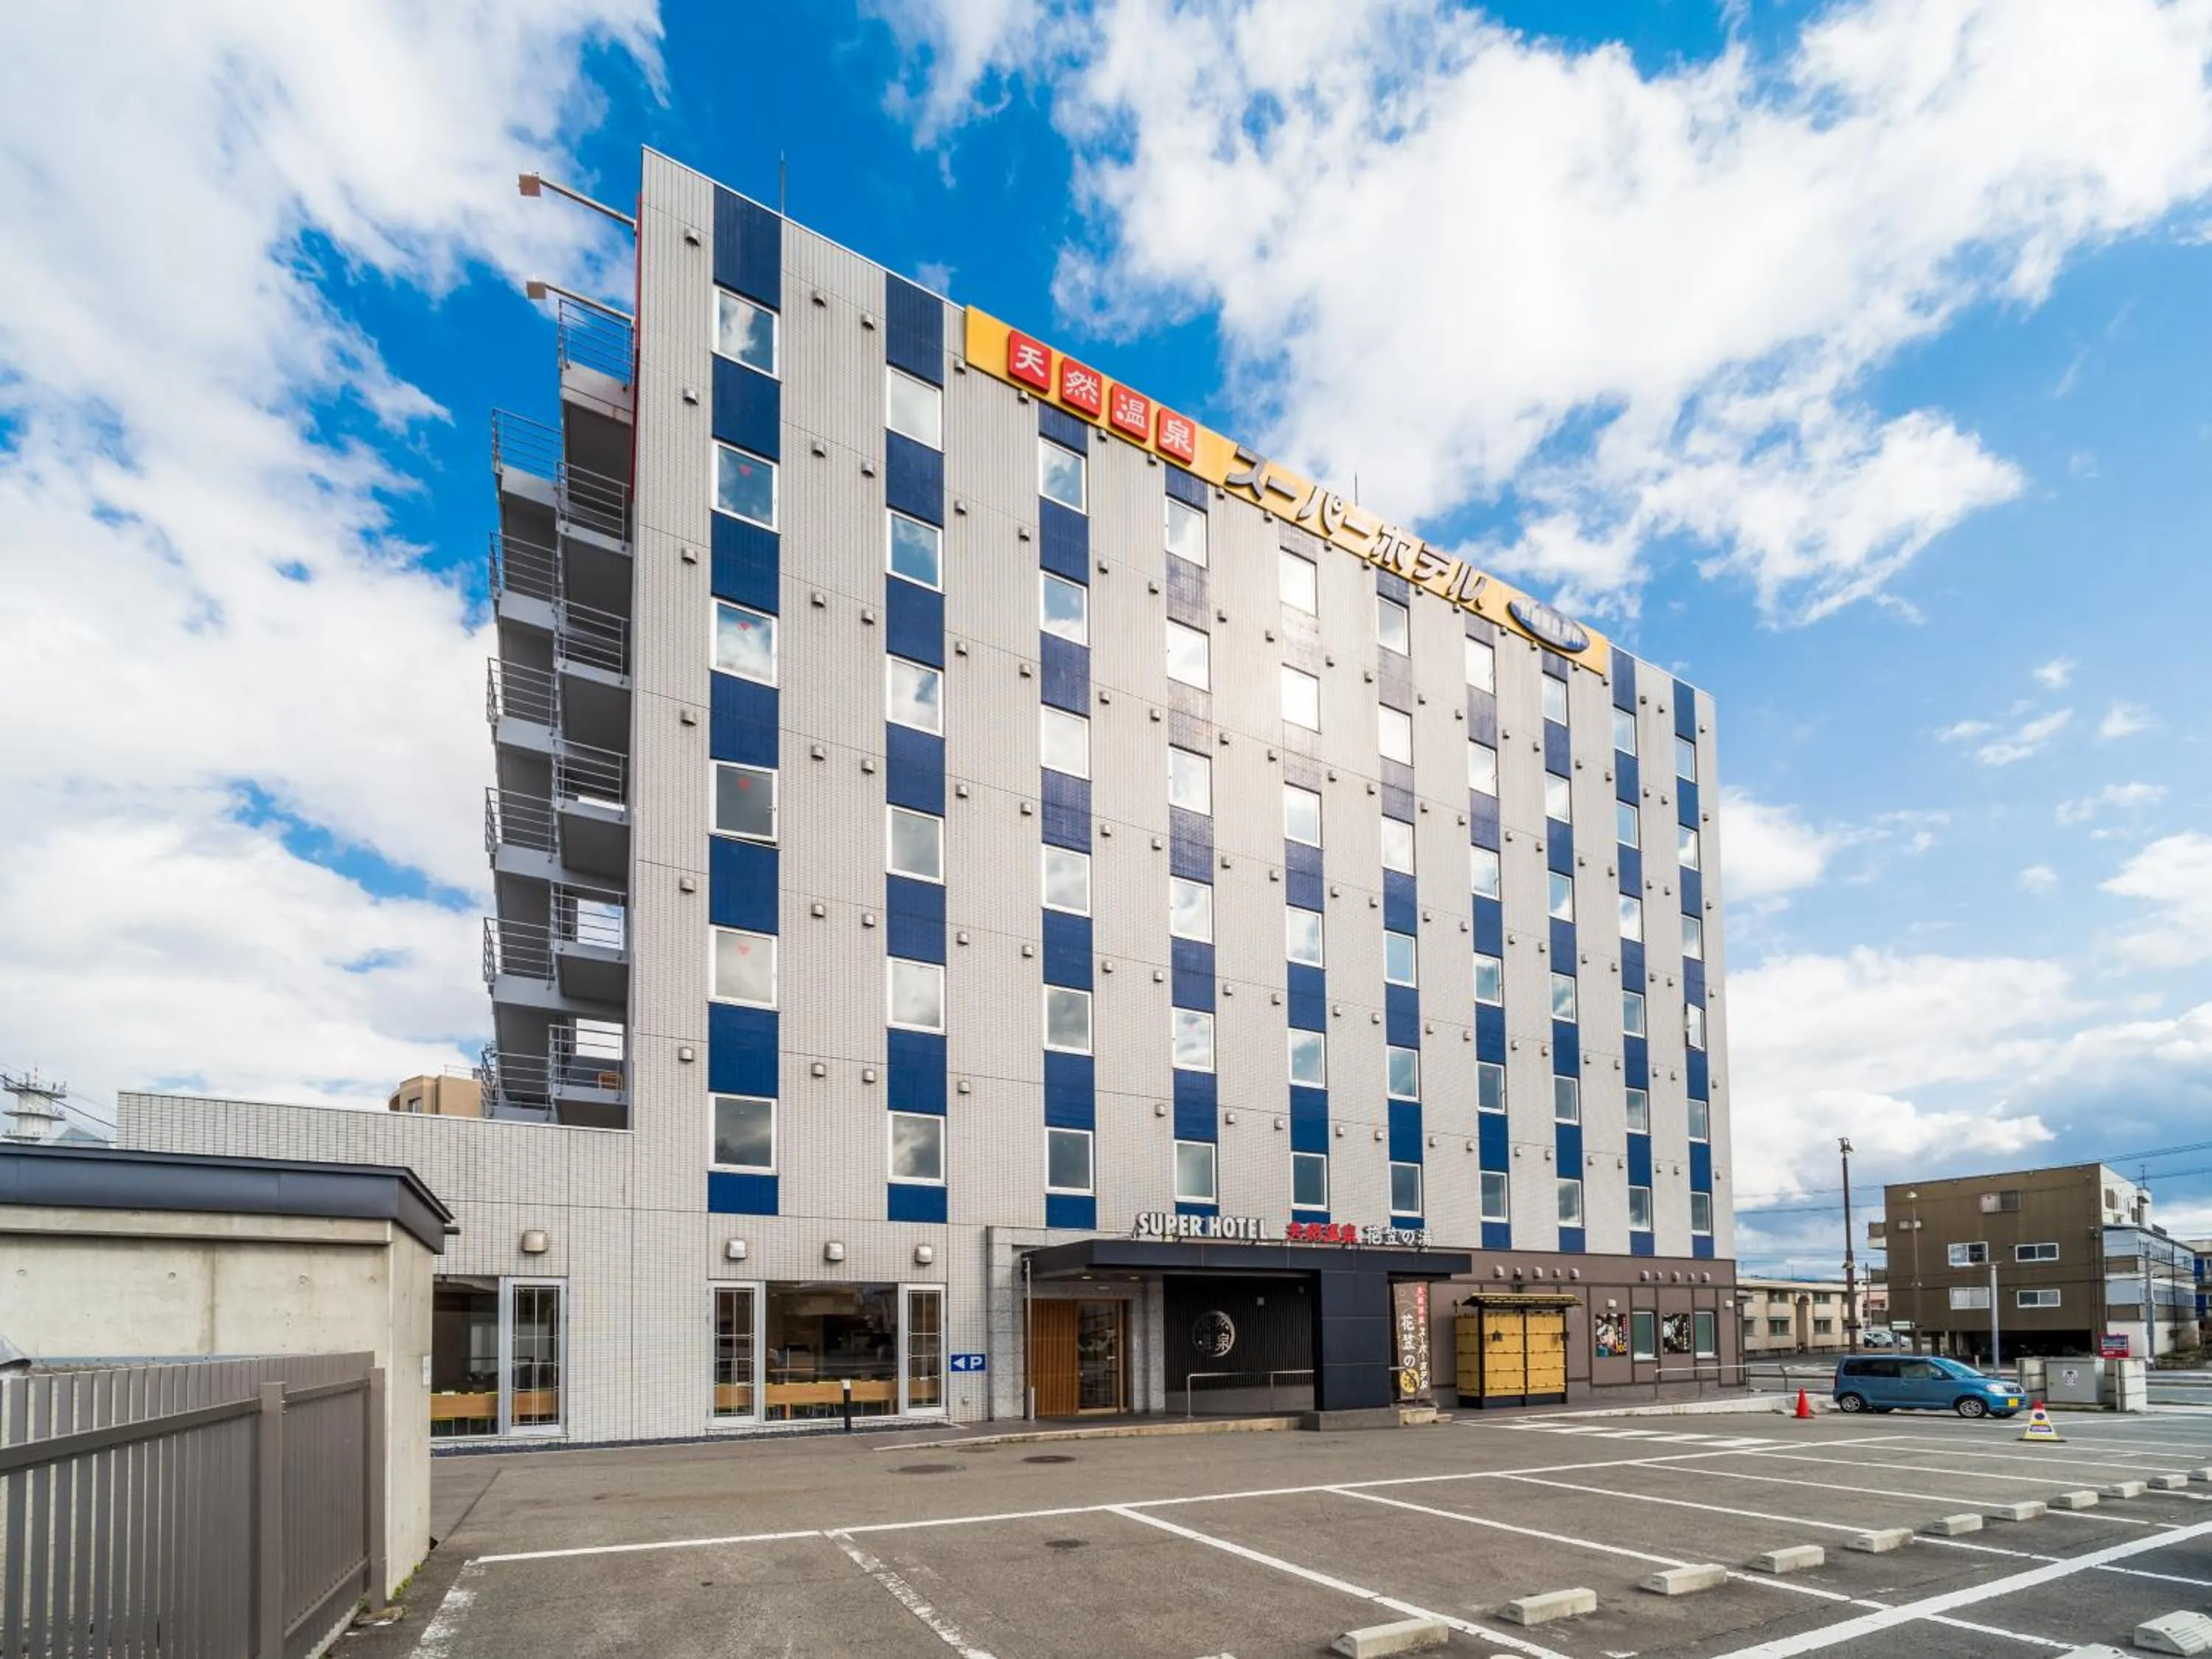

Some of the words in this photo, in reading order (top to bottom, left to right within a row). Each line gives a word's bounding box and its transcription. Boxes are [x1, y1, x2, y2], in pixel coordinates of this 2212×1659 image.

[1015, 344, 1192, 453] 天然温泉
[1225, 444, 1486, 611] スーパーホテル
[1138, 1212, 1203, 1237] SUPER
[1209, 1217, 1269, 1240] HOTEL
[970, 1356, 983, 1369] P
